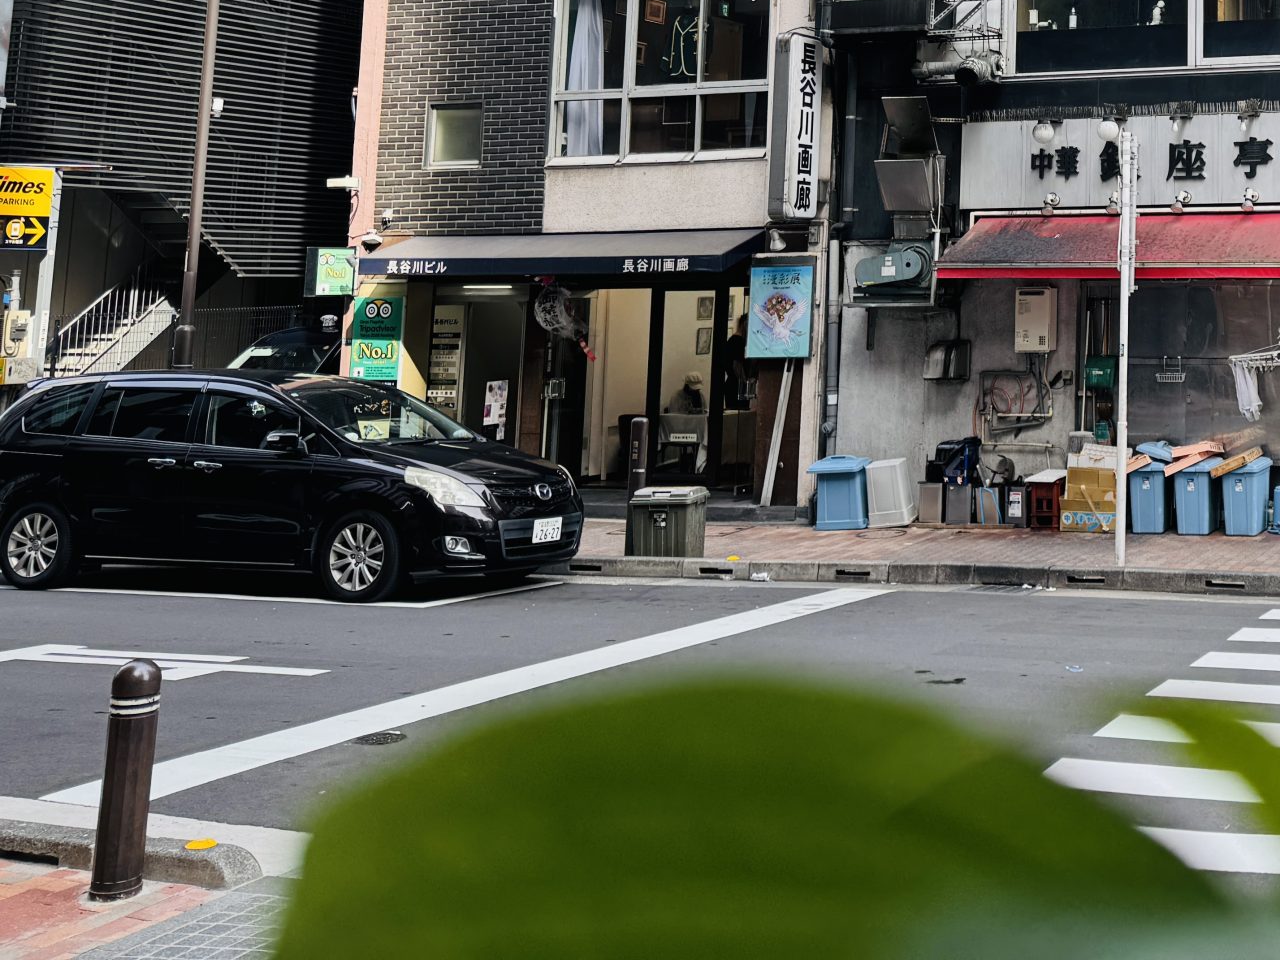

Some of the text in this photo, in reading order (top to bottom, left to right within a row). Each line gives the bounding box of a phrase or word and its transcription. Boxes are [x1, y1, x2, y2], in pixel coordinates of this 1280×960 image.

[794, 42, 817, 212] 長谷川画廊
[1031, 146, 1080, 182] 中華
[387, 260, 447, 274] 長谷川ビル
[622, 258, 689, 273] 長谷川画廊
[359, 324, 397, 334] Tripadvisor
[359, 342, 393, 359] No.1
[540, 527, 560, 541] 26-27
